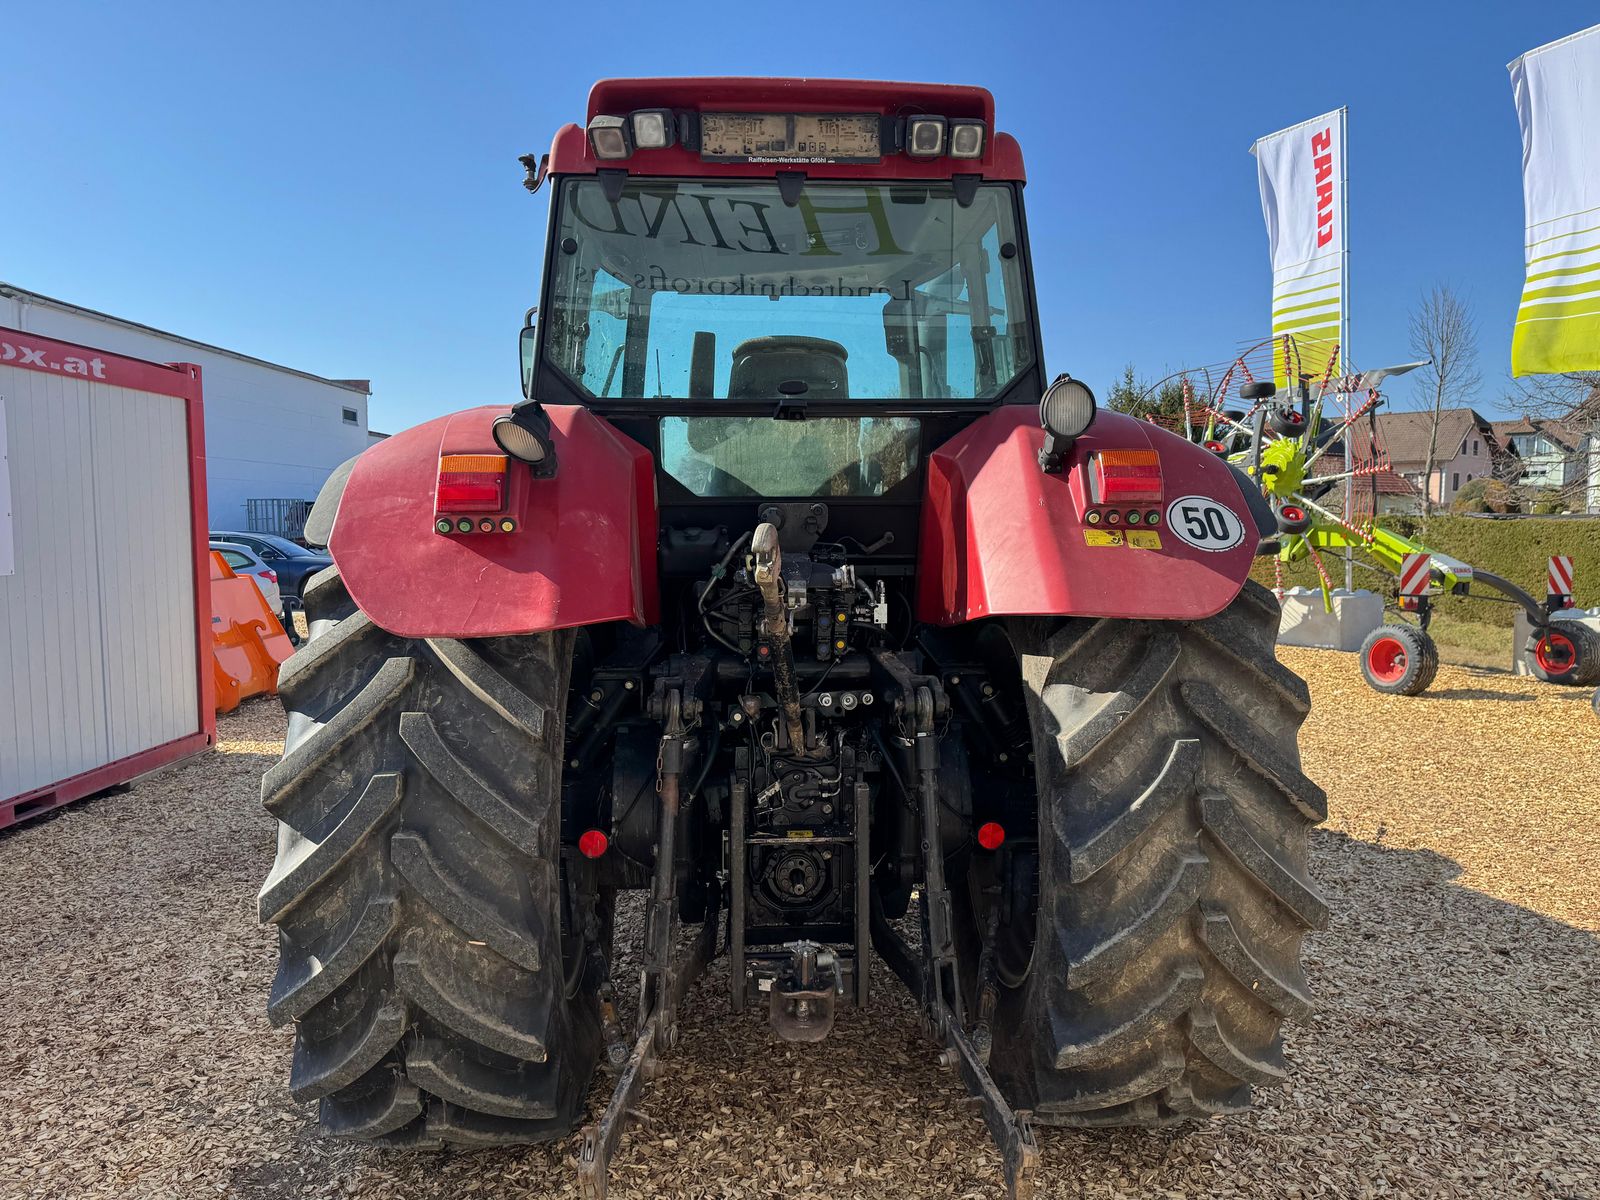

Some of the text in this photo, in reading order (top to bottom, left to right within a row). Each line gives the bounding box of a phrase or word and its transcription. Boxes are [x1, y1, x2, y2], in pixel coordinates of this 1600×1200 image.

[748, 156, 810, 164] Raiffeisen-Werkstätte
[810, 156, 827, 164] Gföhl
[1181, 506, 1230, 541] 50
